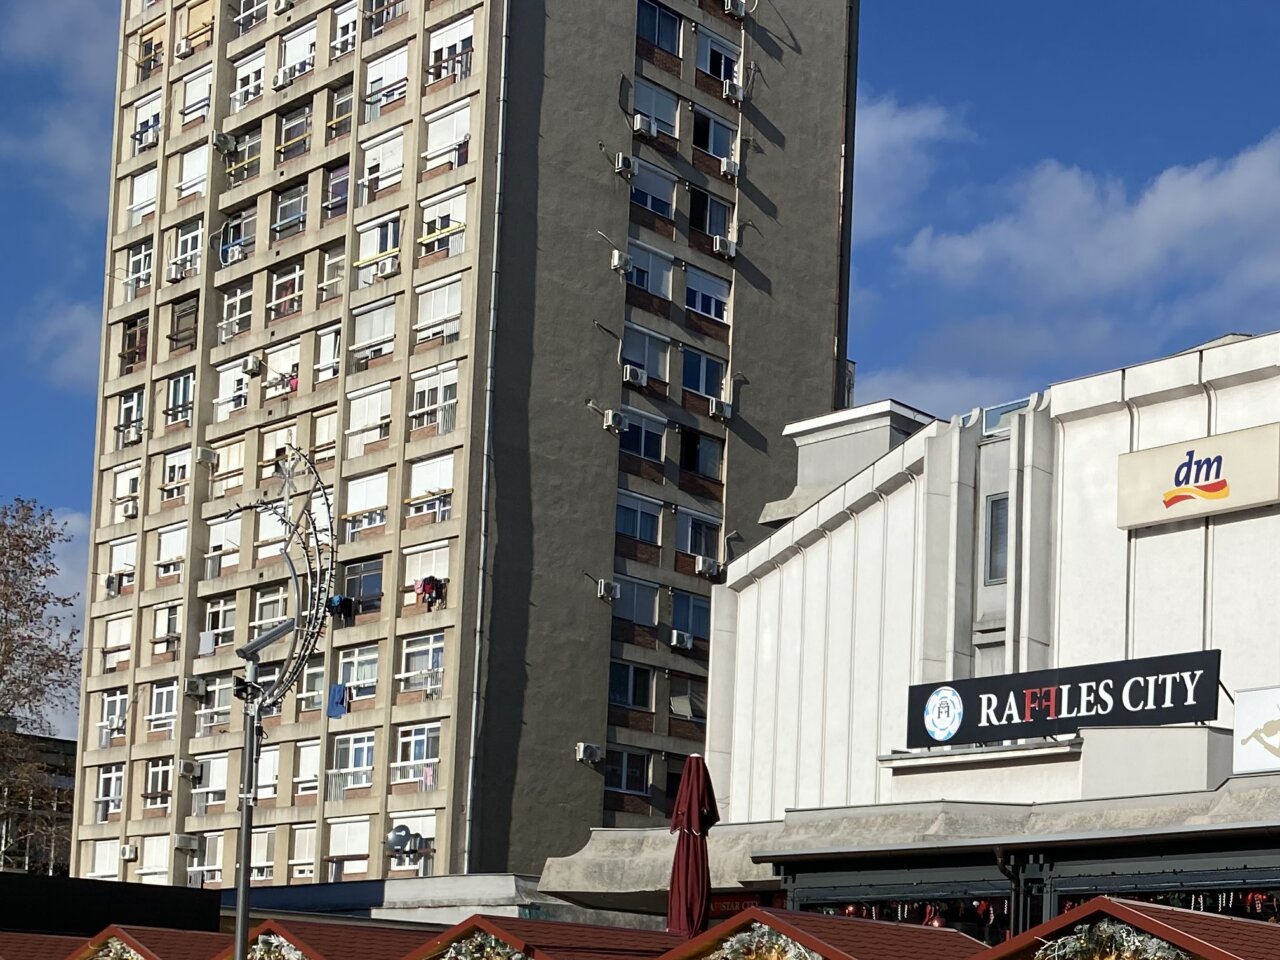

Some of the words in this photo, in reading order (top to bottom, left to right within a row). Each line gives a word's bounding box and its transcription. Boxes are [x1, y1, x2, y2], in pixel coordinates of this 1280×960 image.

[1174, 450, 1223, 488] dm
[978, 679, 1114, 728] RAFFLES
[1121, 669, 1203, 710] CITY
